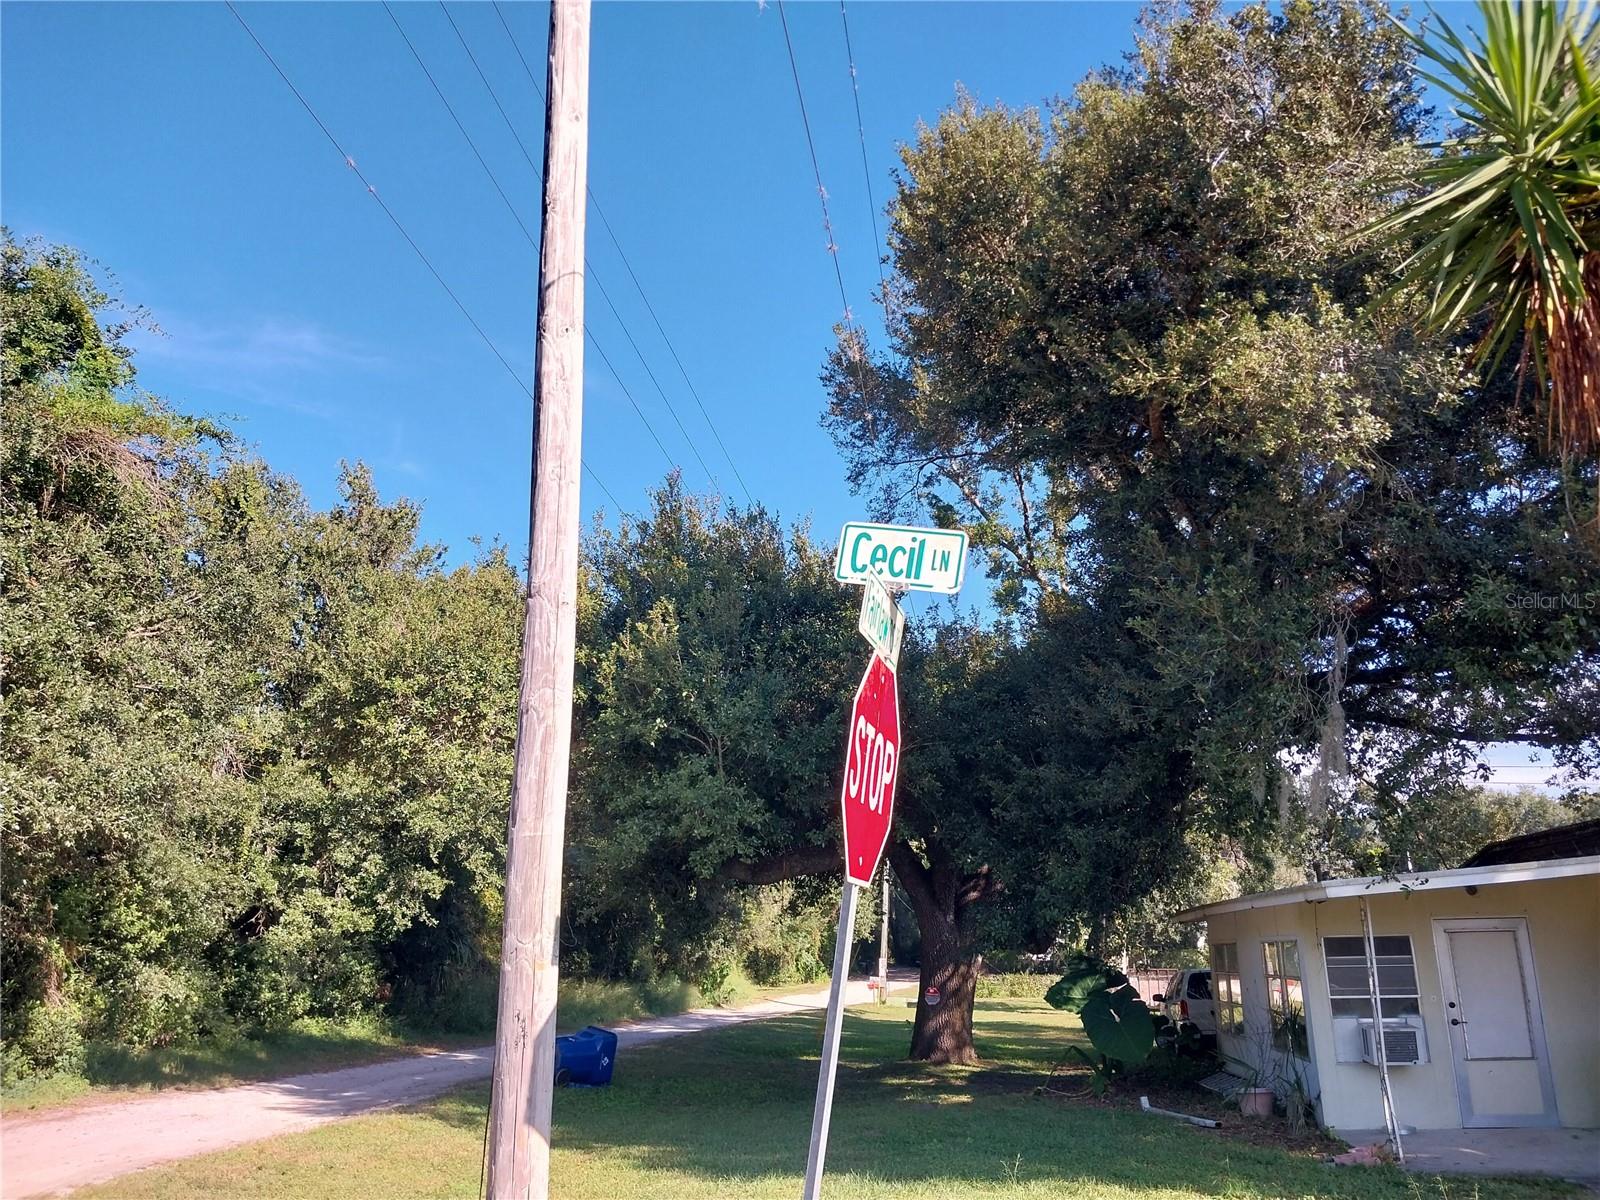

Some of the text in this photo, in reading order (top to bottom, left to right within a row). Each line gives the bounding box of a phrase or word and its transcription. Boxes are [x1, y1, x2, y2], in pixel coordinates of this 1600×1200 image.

[851, 532, 951, 580] Cecil LN
[849, 715, 895, 815] STOP
